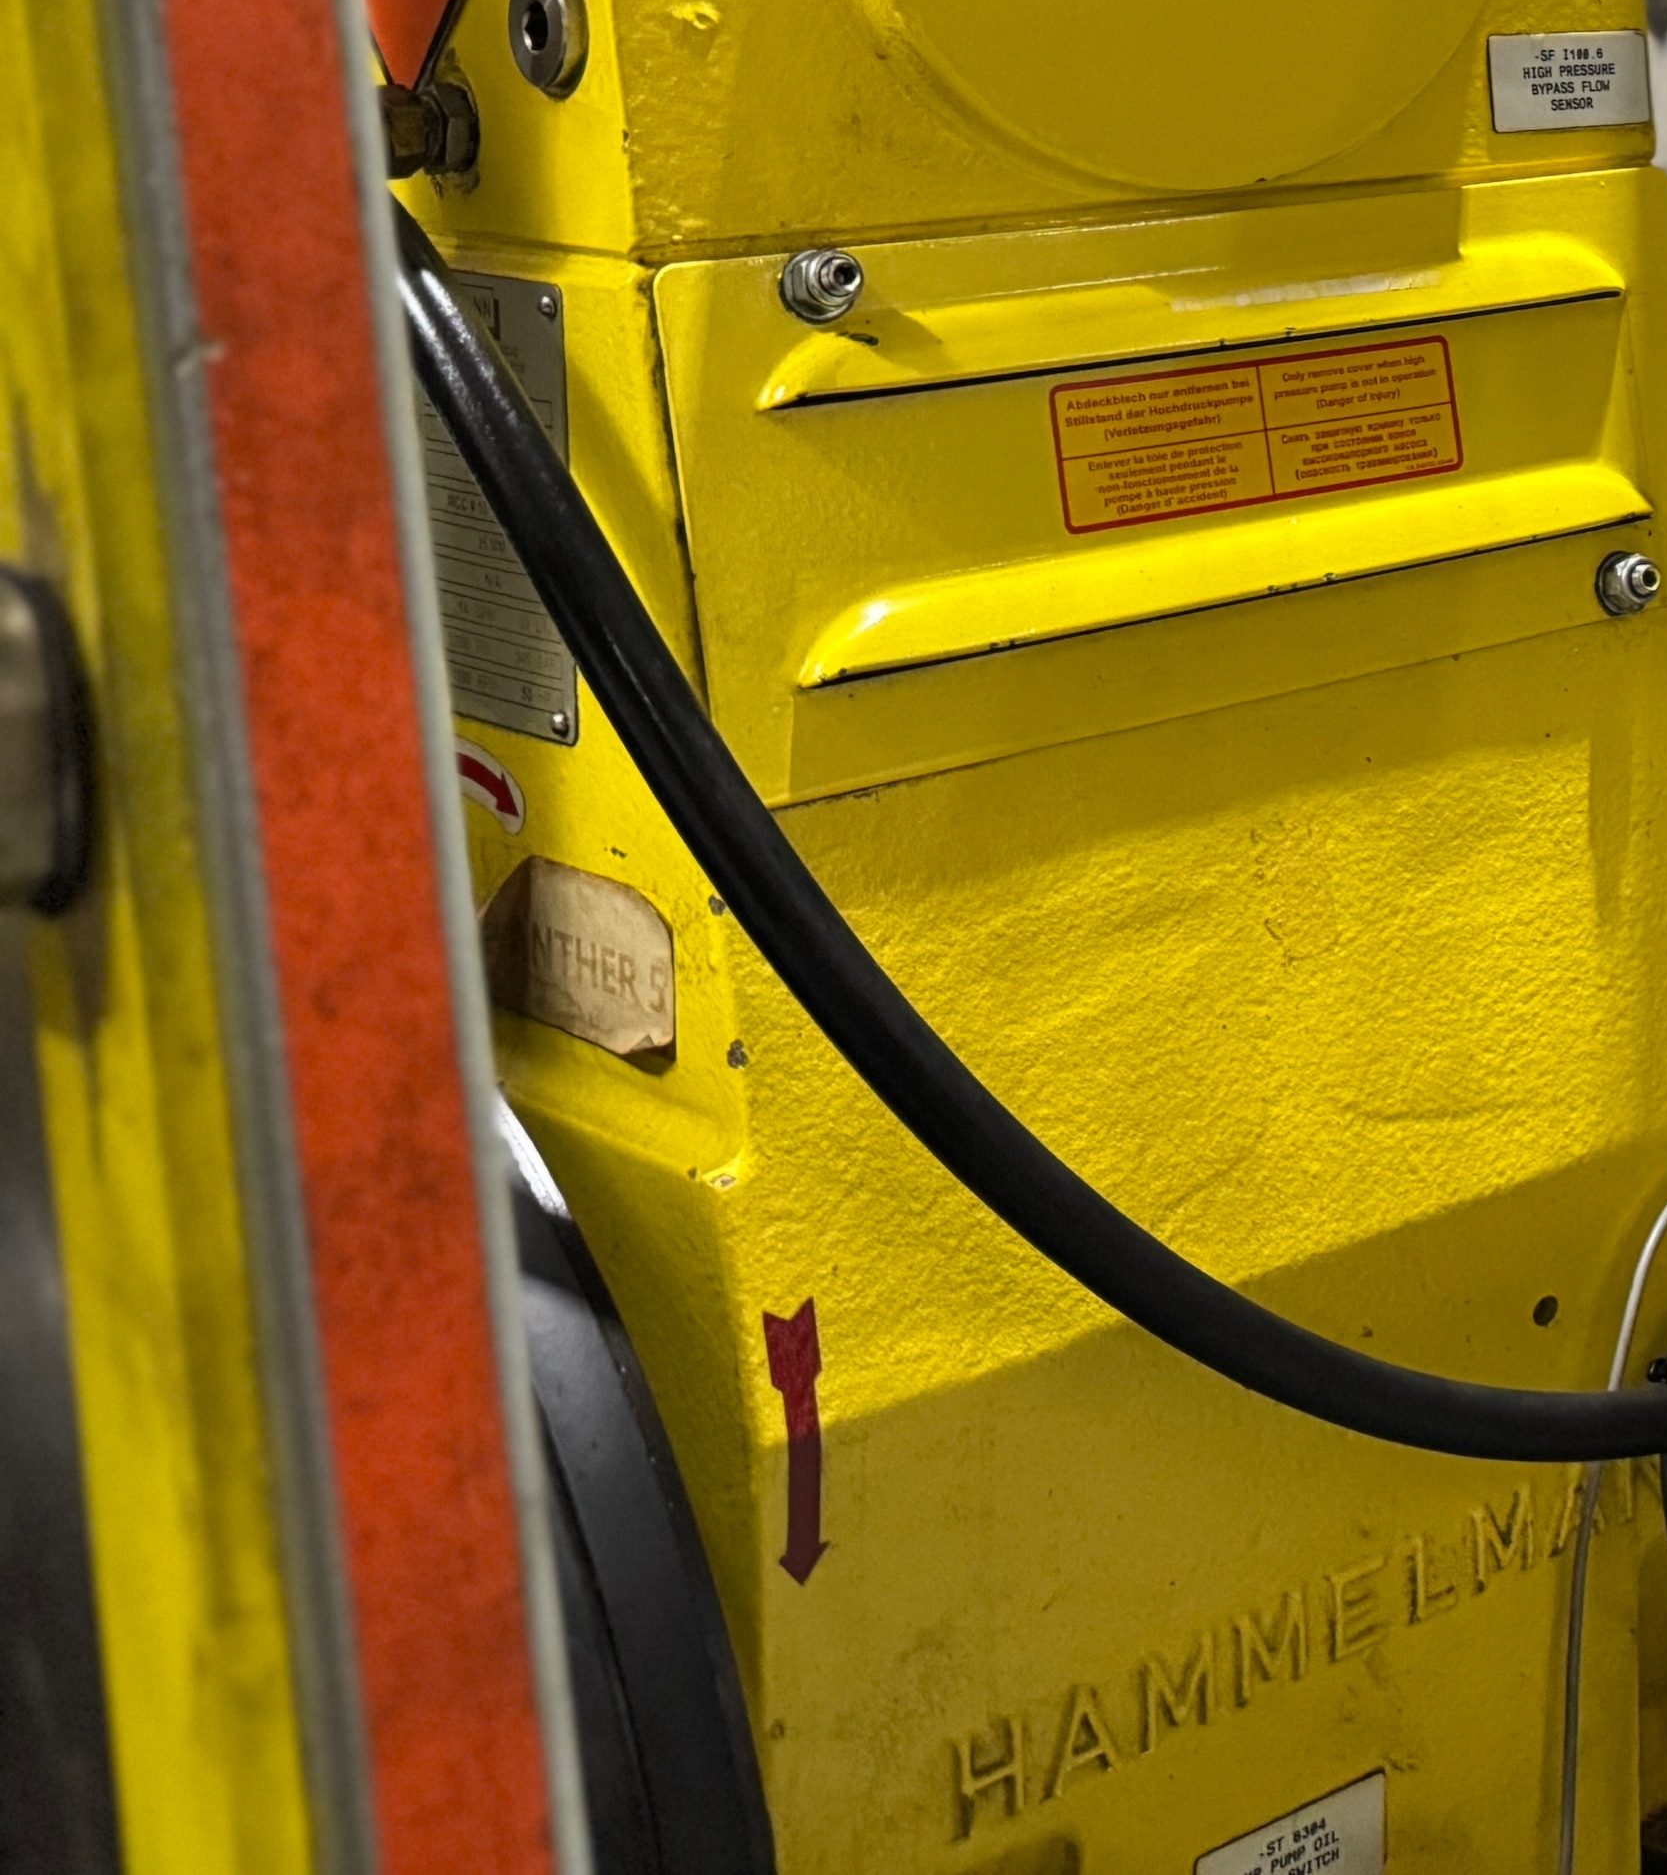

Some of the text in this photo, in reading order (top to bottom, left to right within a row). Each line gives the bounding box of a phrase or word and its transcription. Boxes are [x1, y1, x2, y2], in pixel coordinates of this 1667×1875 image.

[1523, 63, 1616, 79] HIGH PRESSURE
[1531, 80, 1610, 95] BYPASS FLOW
[1551, 98, 1594, 111] SENSOR
[1282, 355, 1425, 383] Only remove cover when high
[1150, 390, 1169, 400] nur
[1173, 382, 1228, 397] entfernen
[1232, 379, 1249, 389] bei
[1274, 368, 1436, 400] pressure pump is not in operation
[1126, 407, 1146, 418] der
[1149, 395, 1254, 416] Hochdruckpumpe
[1316, 388, 1401, 409] (Danger of injury)
[1088, 457, 1131, 472] Enlever
[1134, 455, 1144, 464] la
[1171, 449, 1184, 459] de
[1187, 441, 1243, 458] protection
[1109, 455, 1227, 480] seulement pendant le
[1098, 464, 1239, 493] non-fonctionnement de la
[1104, 491, 1142, 507] pompe
[1156, 484, 1187, 497] haute
[1190, 477, 1237, 493] pression
[1117, 501, 1161, 516] (Danger
[1177, 490, 1227, 506] accident)
[1259, 1835, 1285, 1857] -ST
[1271, 1845, 1306, 1874] PUMP
[1314, 1830, 1340, 1851] OIL
[1288, 1847, 1340, 1875] SWITCH
